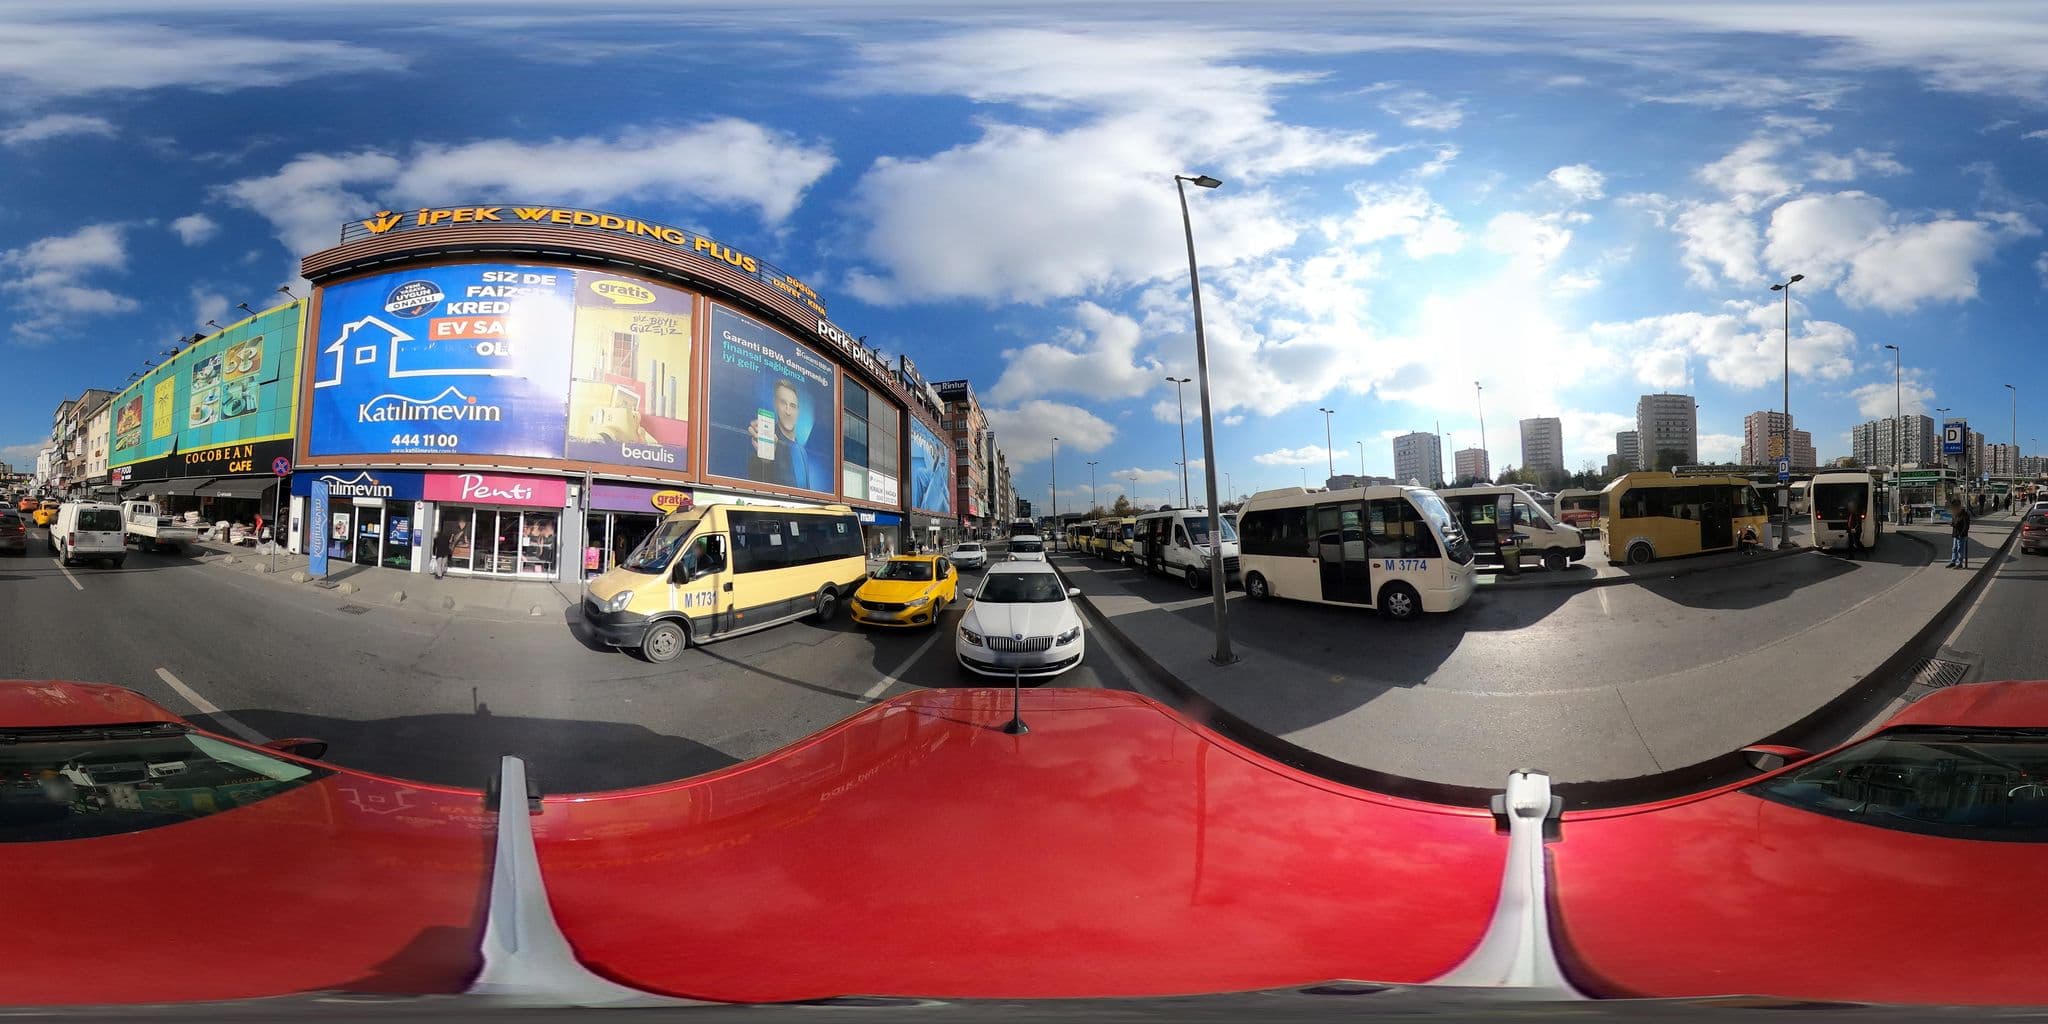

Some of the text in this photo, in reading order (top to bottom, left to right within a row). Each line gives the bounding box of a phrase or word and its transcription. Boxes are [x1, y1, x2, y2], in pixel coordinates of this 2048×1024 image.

[417, 207, 757, 274] İPEK WEDDING PLUS
[523, 273, 557, 286] DE
[396, 289, 431, 301] UYGUN
[598, 283, 649, 300] gratis
[393, 295, 435, 309] ONAYLI
[437, 320, 468, 336] EV
[722, 340, 762, 363] finansal
[723, 330, 760, 352] Garanti
[762, 345, 785, 363] BBVA
[817, 319, 853, 351] park
[853, 342, 875, 371] plus
[942, 382, 967, 390] Rintur
[359, 396, 501, 423] Katılımevim
[391, 434, 420, 447] 444
[1948, 430, 1957, 441] D
[185, 445, 254, 465] COCOBEAN
[622, 442, 674, 463] beaulis
[229, 460, 252, 473] CAFE
[328, 480, 393, 497] tılımevim
[458, 473, 532, 500] Penti
[1385, 560, 1427, 571] M 3774
[685, 591, 718, 608] M 1731
